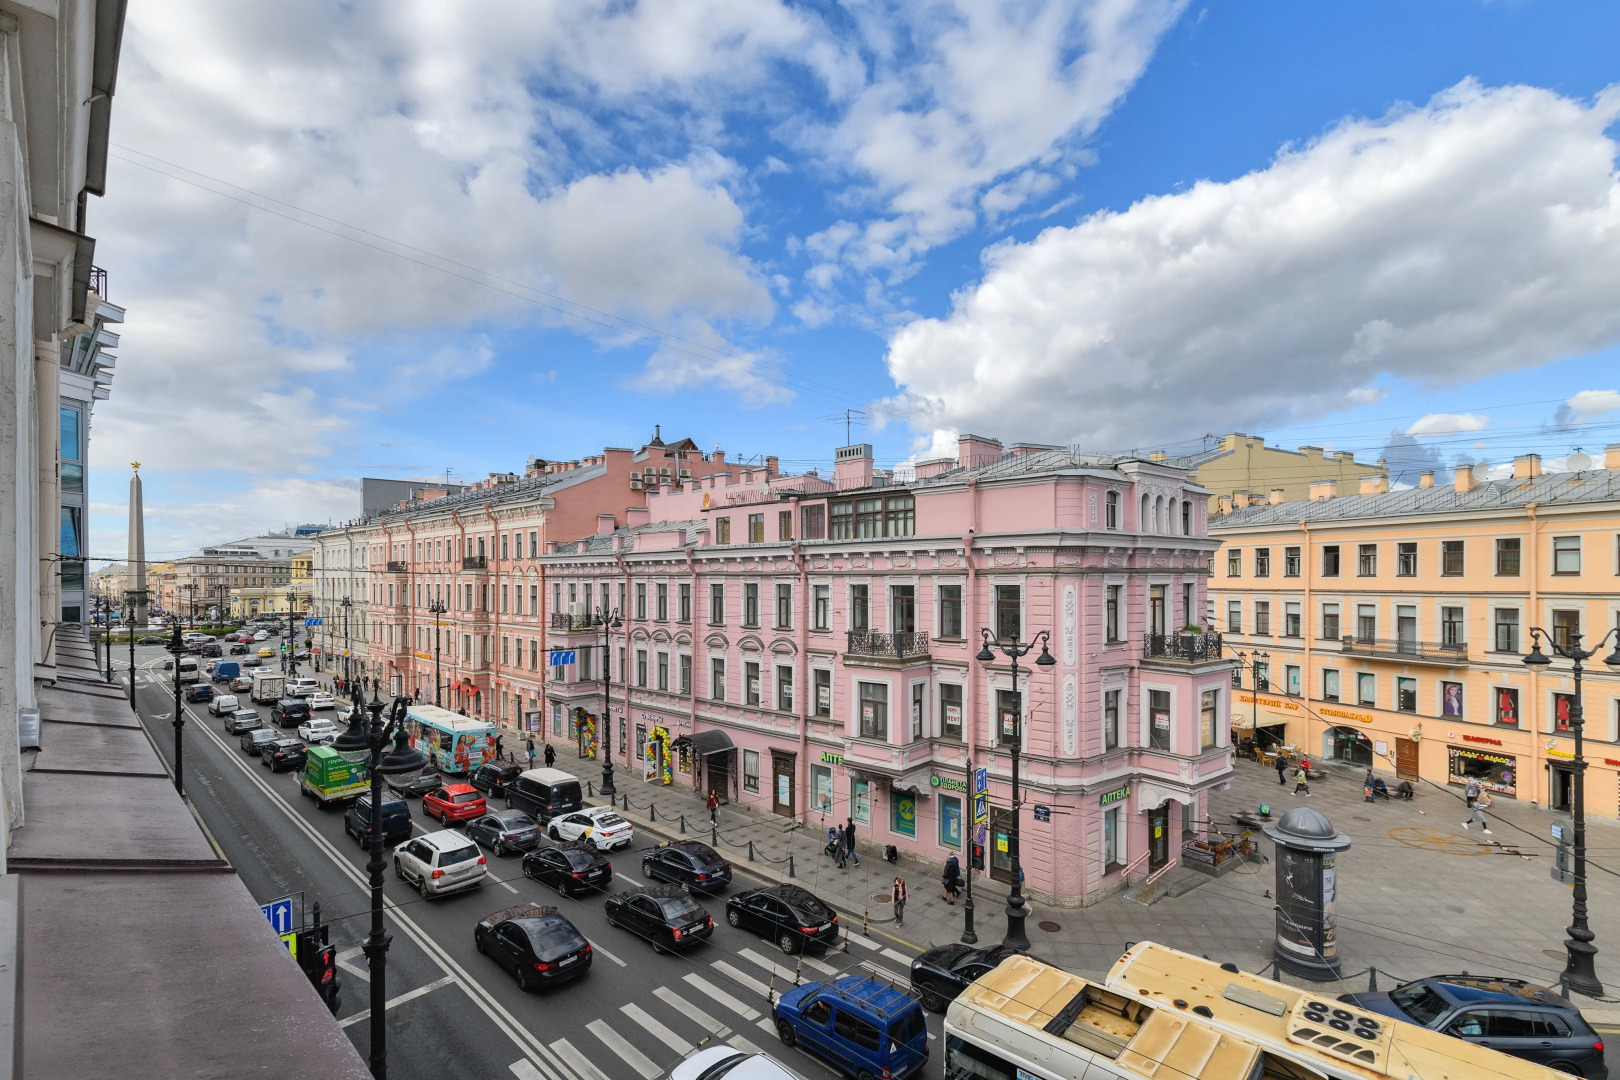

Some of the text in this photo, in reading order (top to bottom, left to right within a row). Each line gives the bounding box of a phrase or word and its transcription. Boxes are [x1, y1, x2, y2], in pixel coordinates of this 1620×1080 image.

[1318, 708, 1355, 719] СТОЛОВАЯ
[1463, 734, 1502, 746] ШАВЕРМА
[940, 777, 967, 787] ПЛАНЕТА
[1102, 786, 1131, 805] АПТЕКА
[900, 804, 915, 816] 24
